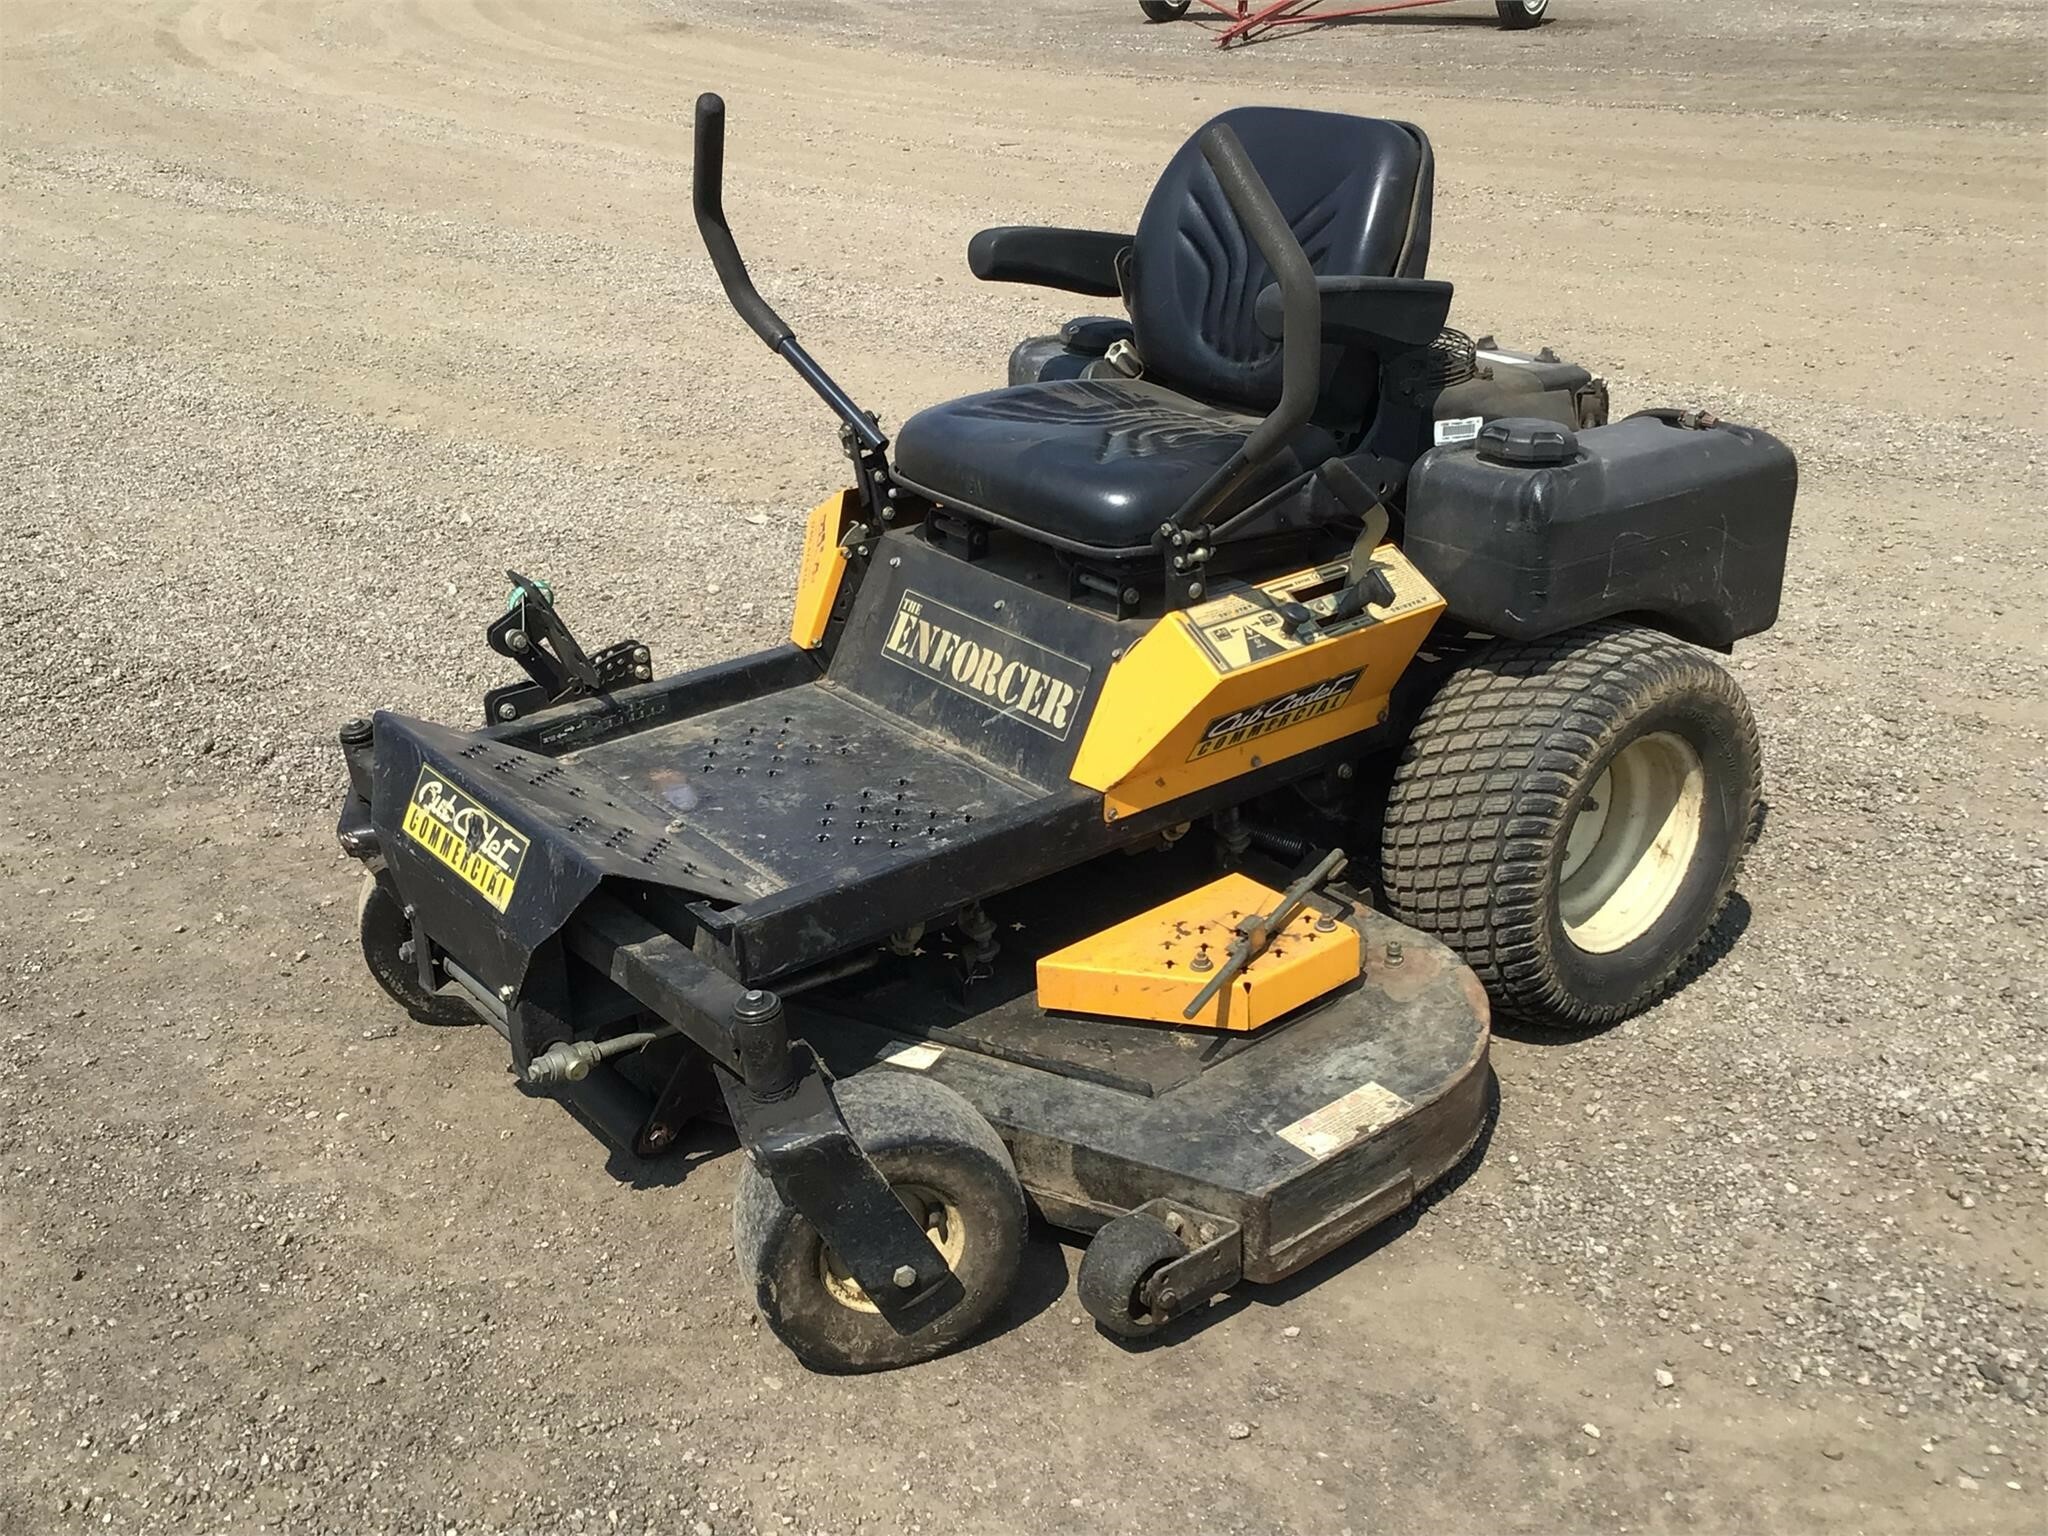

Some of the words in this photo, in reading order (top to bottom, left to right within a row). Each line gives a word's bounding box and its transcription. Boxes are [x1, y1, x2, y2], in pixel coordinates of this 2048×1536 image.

[902, 598, 923, 616] THE
[886, 610, 1074, 729] ENFORCER
[1197, 697, 1339, 757] COMMERCIAL
[1208, 705, 1265, 738] Cub
[1264, 673, 1357, 718] Cadet
[453, 807, 521, 871] Cdet
